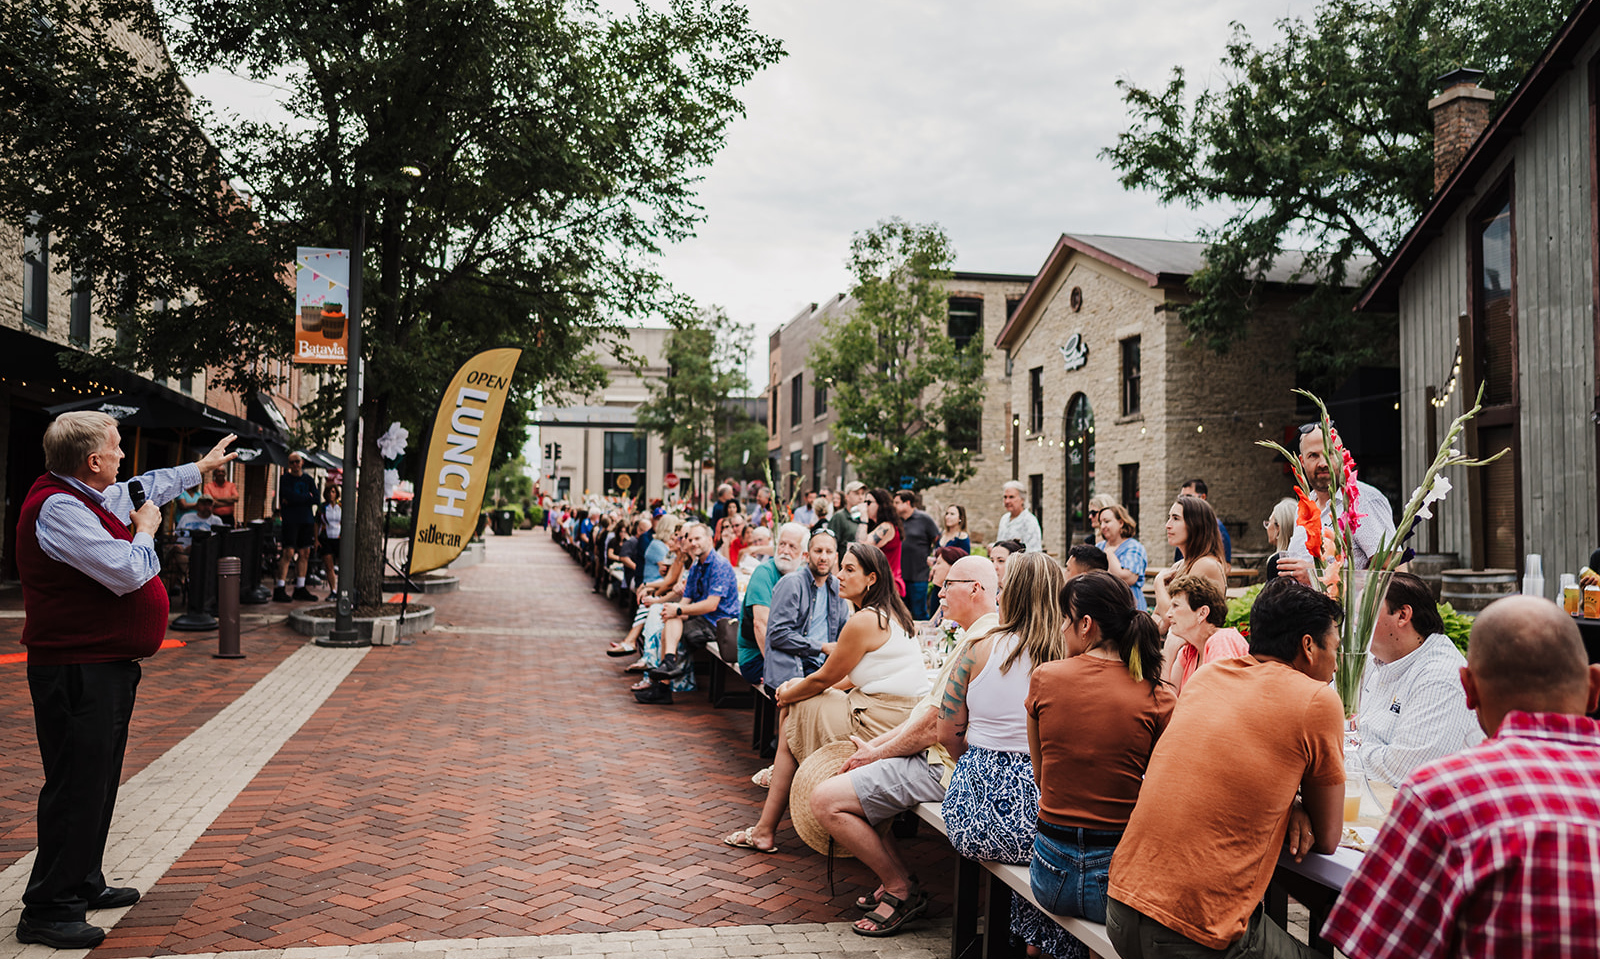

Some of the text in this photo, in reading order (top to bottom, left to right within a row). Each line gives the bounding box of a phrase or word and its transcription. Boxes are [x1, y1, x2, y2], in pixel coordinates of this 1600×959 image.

[298, 340, 345, 356] Batavia
[467, 370, 508, 390] OPEN
[434, 387, 489, 518] LUNCH
